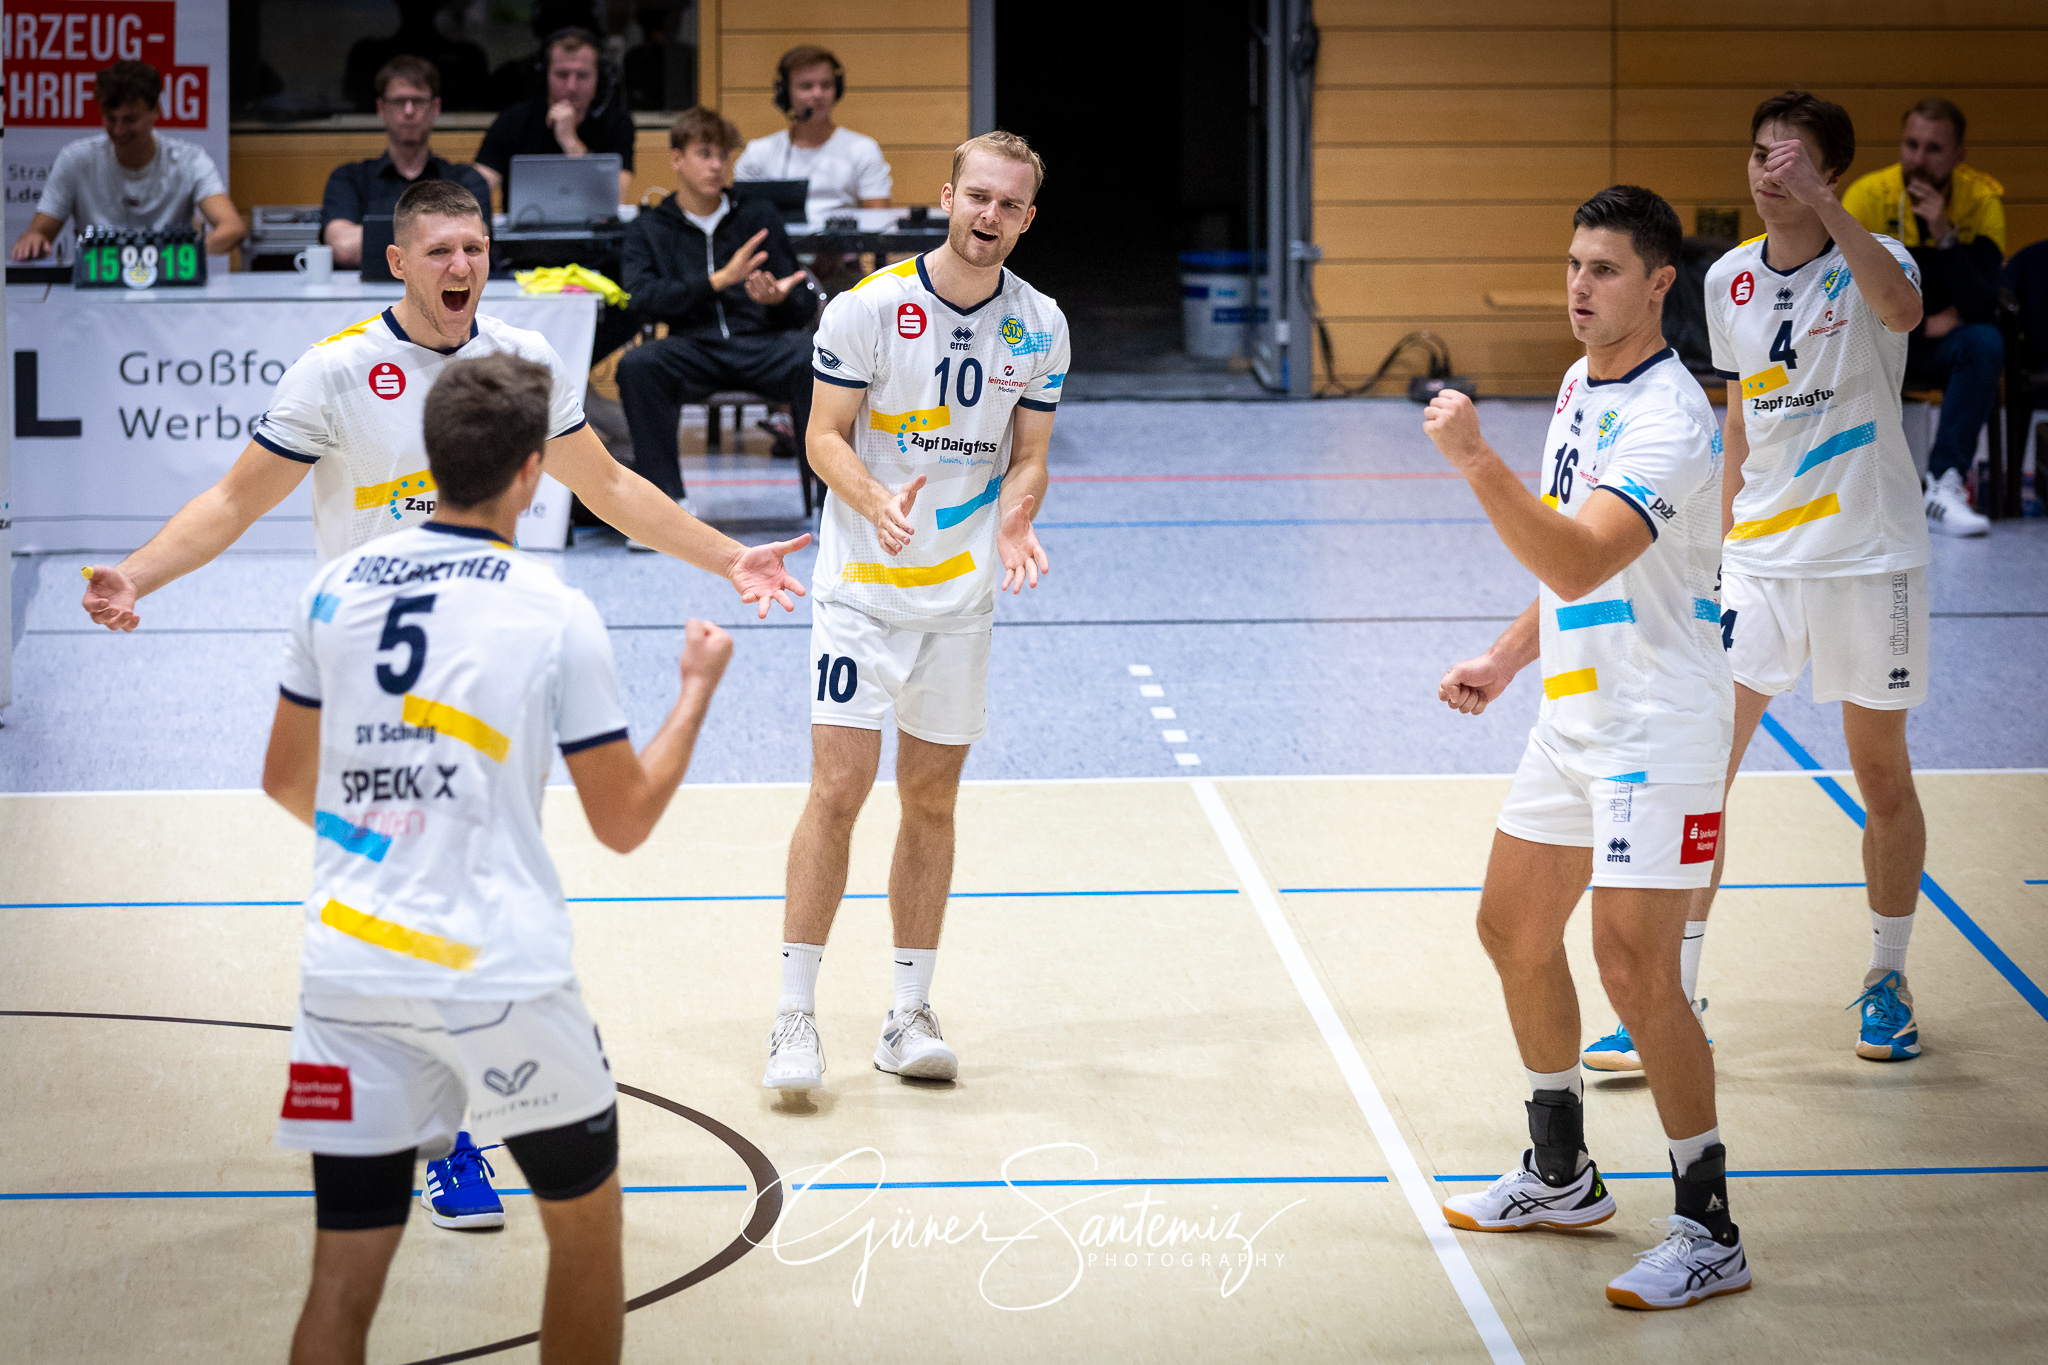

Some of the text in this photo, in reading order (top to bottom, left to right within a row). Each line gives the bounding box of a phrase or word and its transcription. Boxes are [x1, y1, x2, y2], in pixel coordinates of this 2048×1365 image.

[3, 71, 200, 120] HRIFNG
[84, 246, 119, 282] 15
[161, 243, 197, 281] 19
[1768, 320, 1798, 370] 4
[119, 350, 288, 386] Großfo
[934, 356, 983, 408] 10
[14, 351, 82, 438] L
[1754, 396, 1783, 412] Zapf
[911, 432, 998, 455] Zapf Daigfss
[1549, 442, 1579, 504] 16
[375, 593, 438, 696] 5
[817, 653, 857, 703] 10
[1888, 681, 1910, 690] errea
[342, 765, 423, 804] SPECK
[1607, 854, 1631, 863] errea
